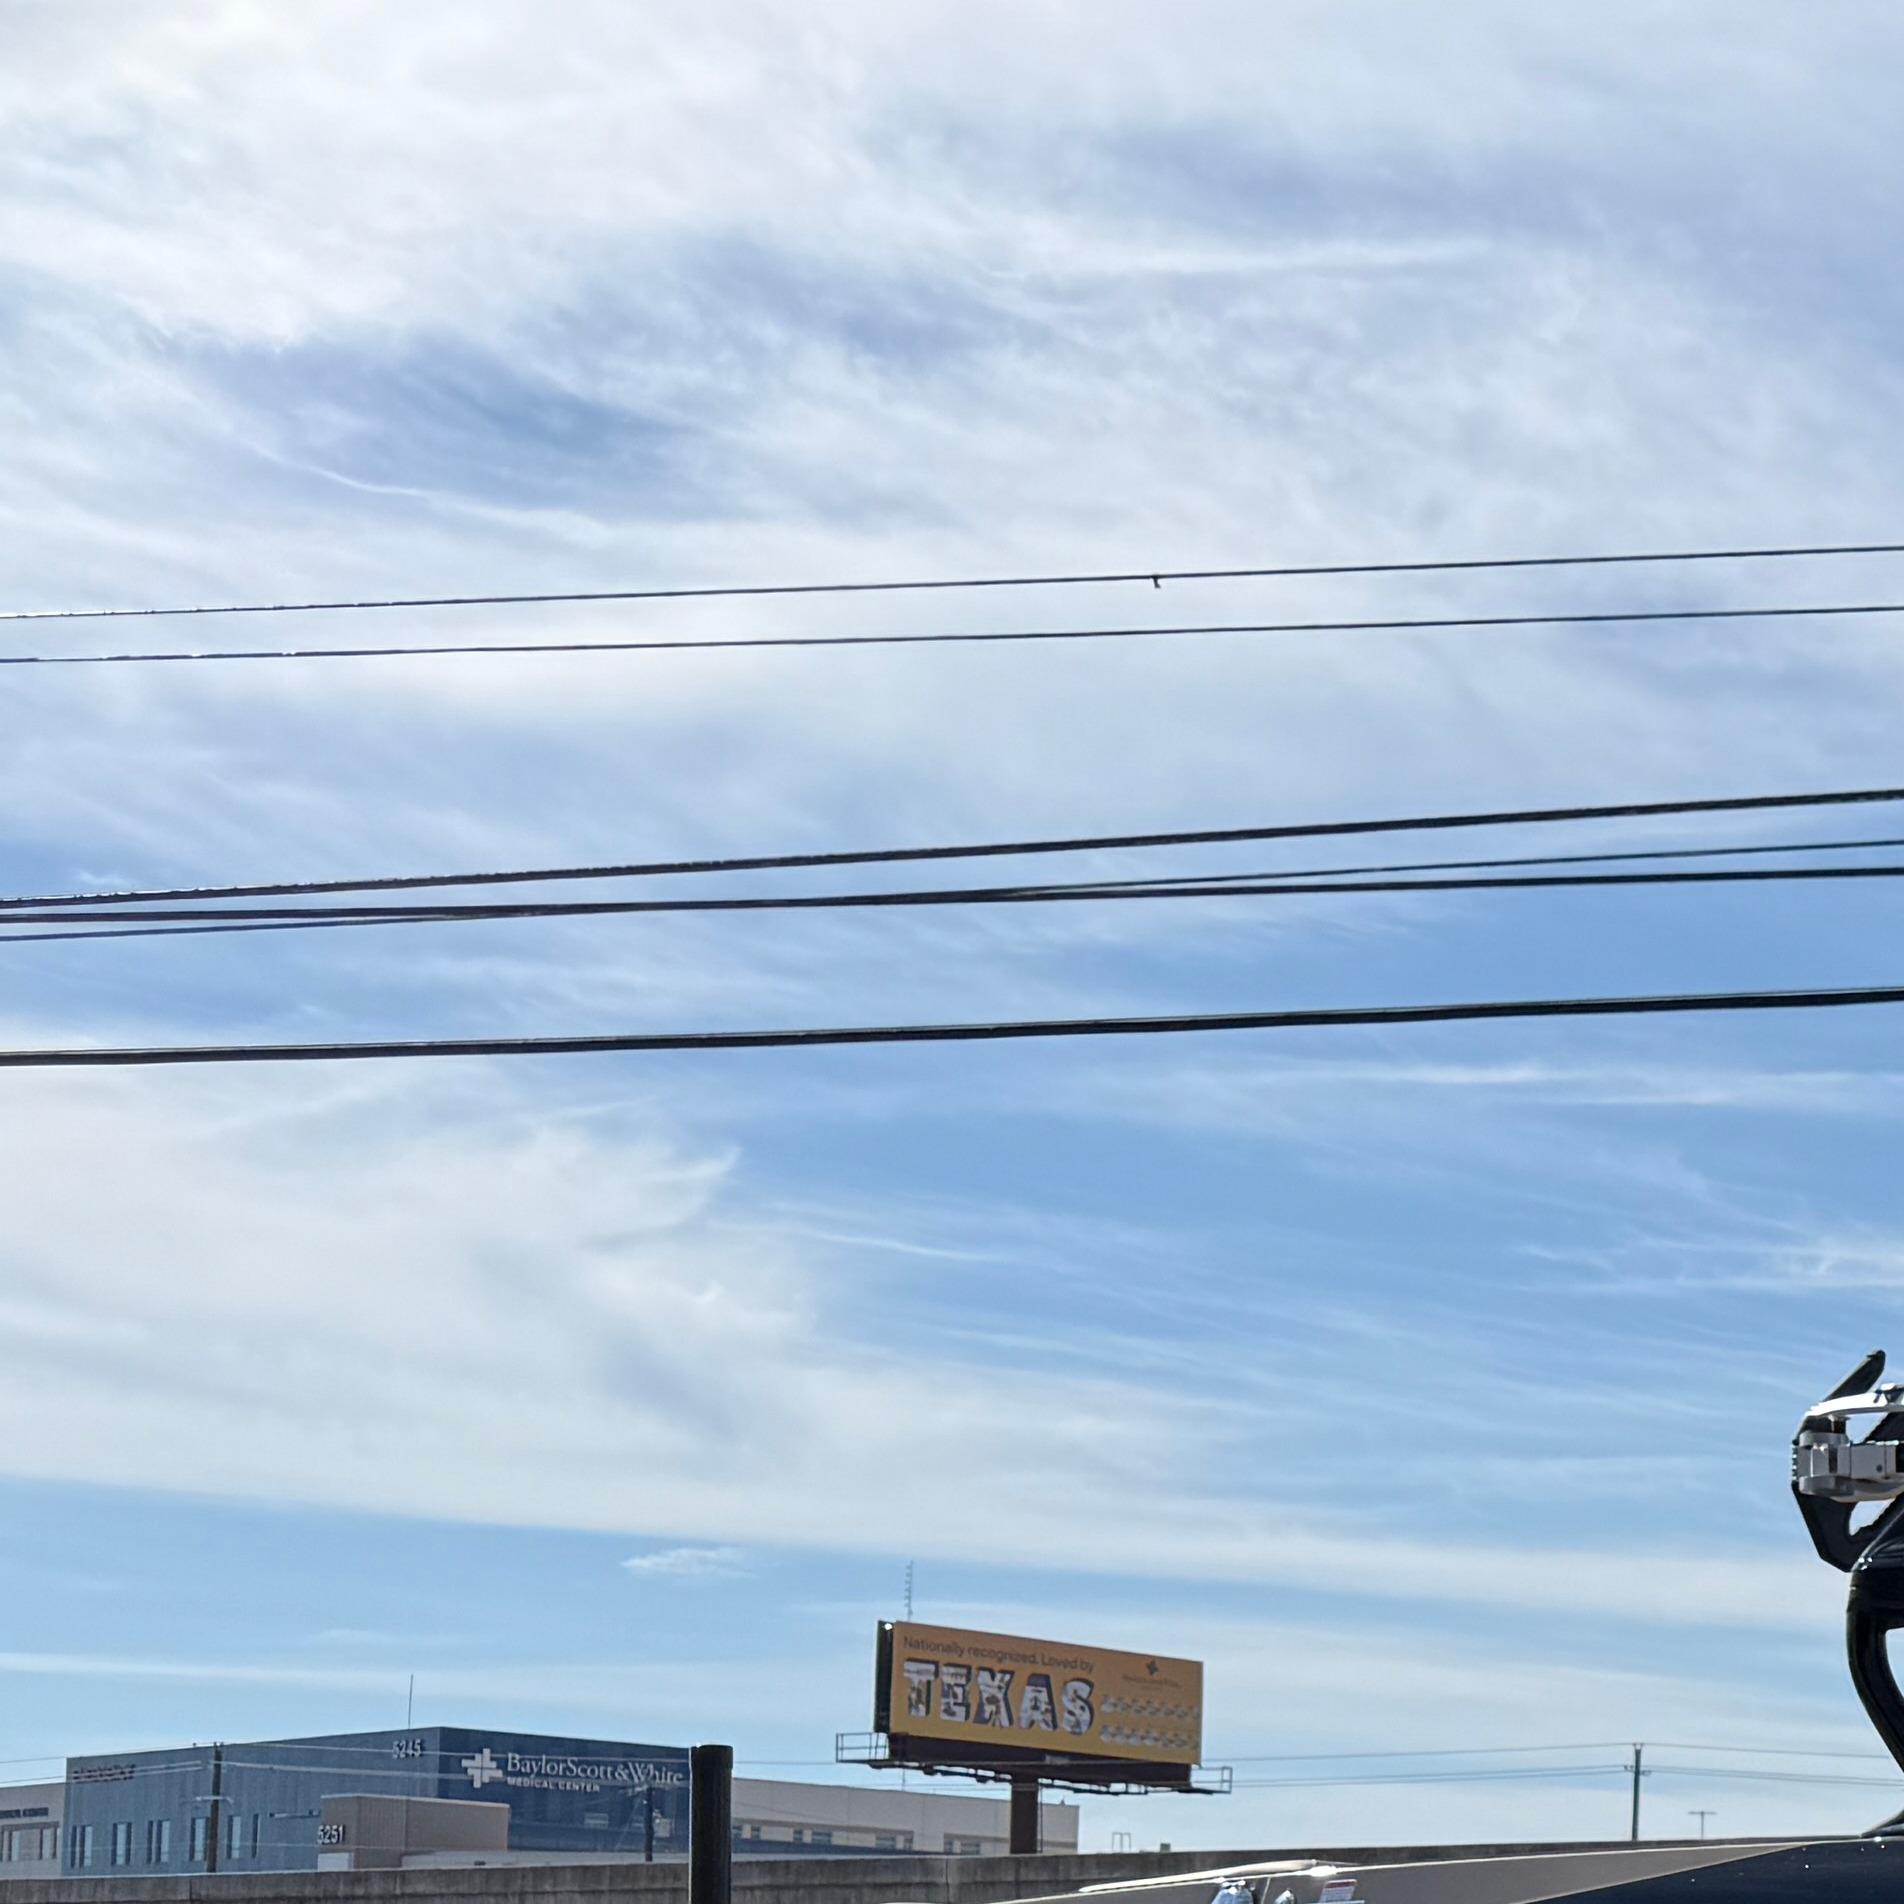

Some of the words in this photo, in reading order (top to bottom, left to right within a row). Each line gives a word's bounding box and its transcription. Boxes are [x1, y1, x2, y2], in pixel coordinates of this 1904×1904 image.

[903, 1636, 965, 1658] Nationally
[1081, 1658, 1095, 1673] by
[903, 1657, 1095, 1735] TEXAS
[391, 1738, 422, 1760] 5245
[507, 1776, 553, 1790] MEDICAL
[558, 1780, 600, 1793] CENTER
[317, 1824, 345, 1845] 5251
